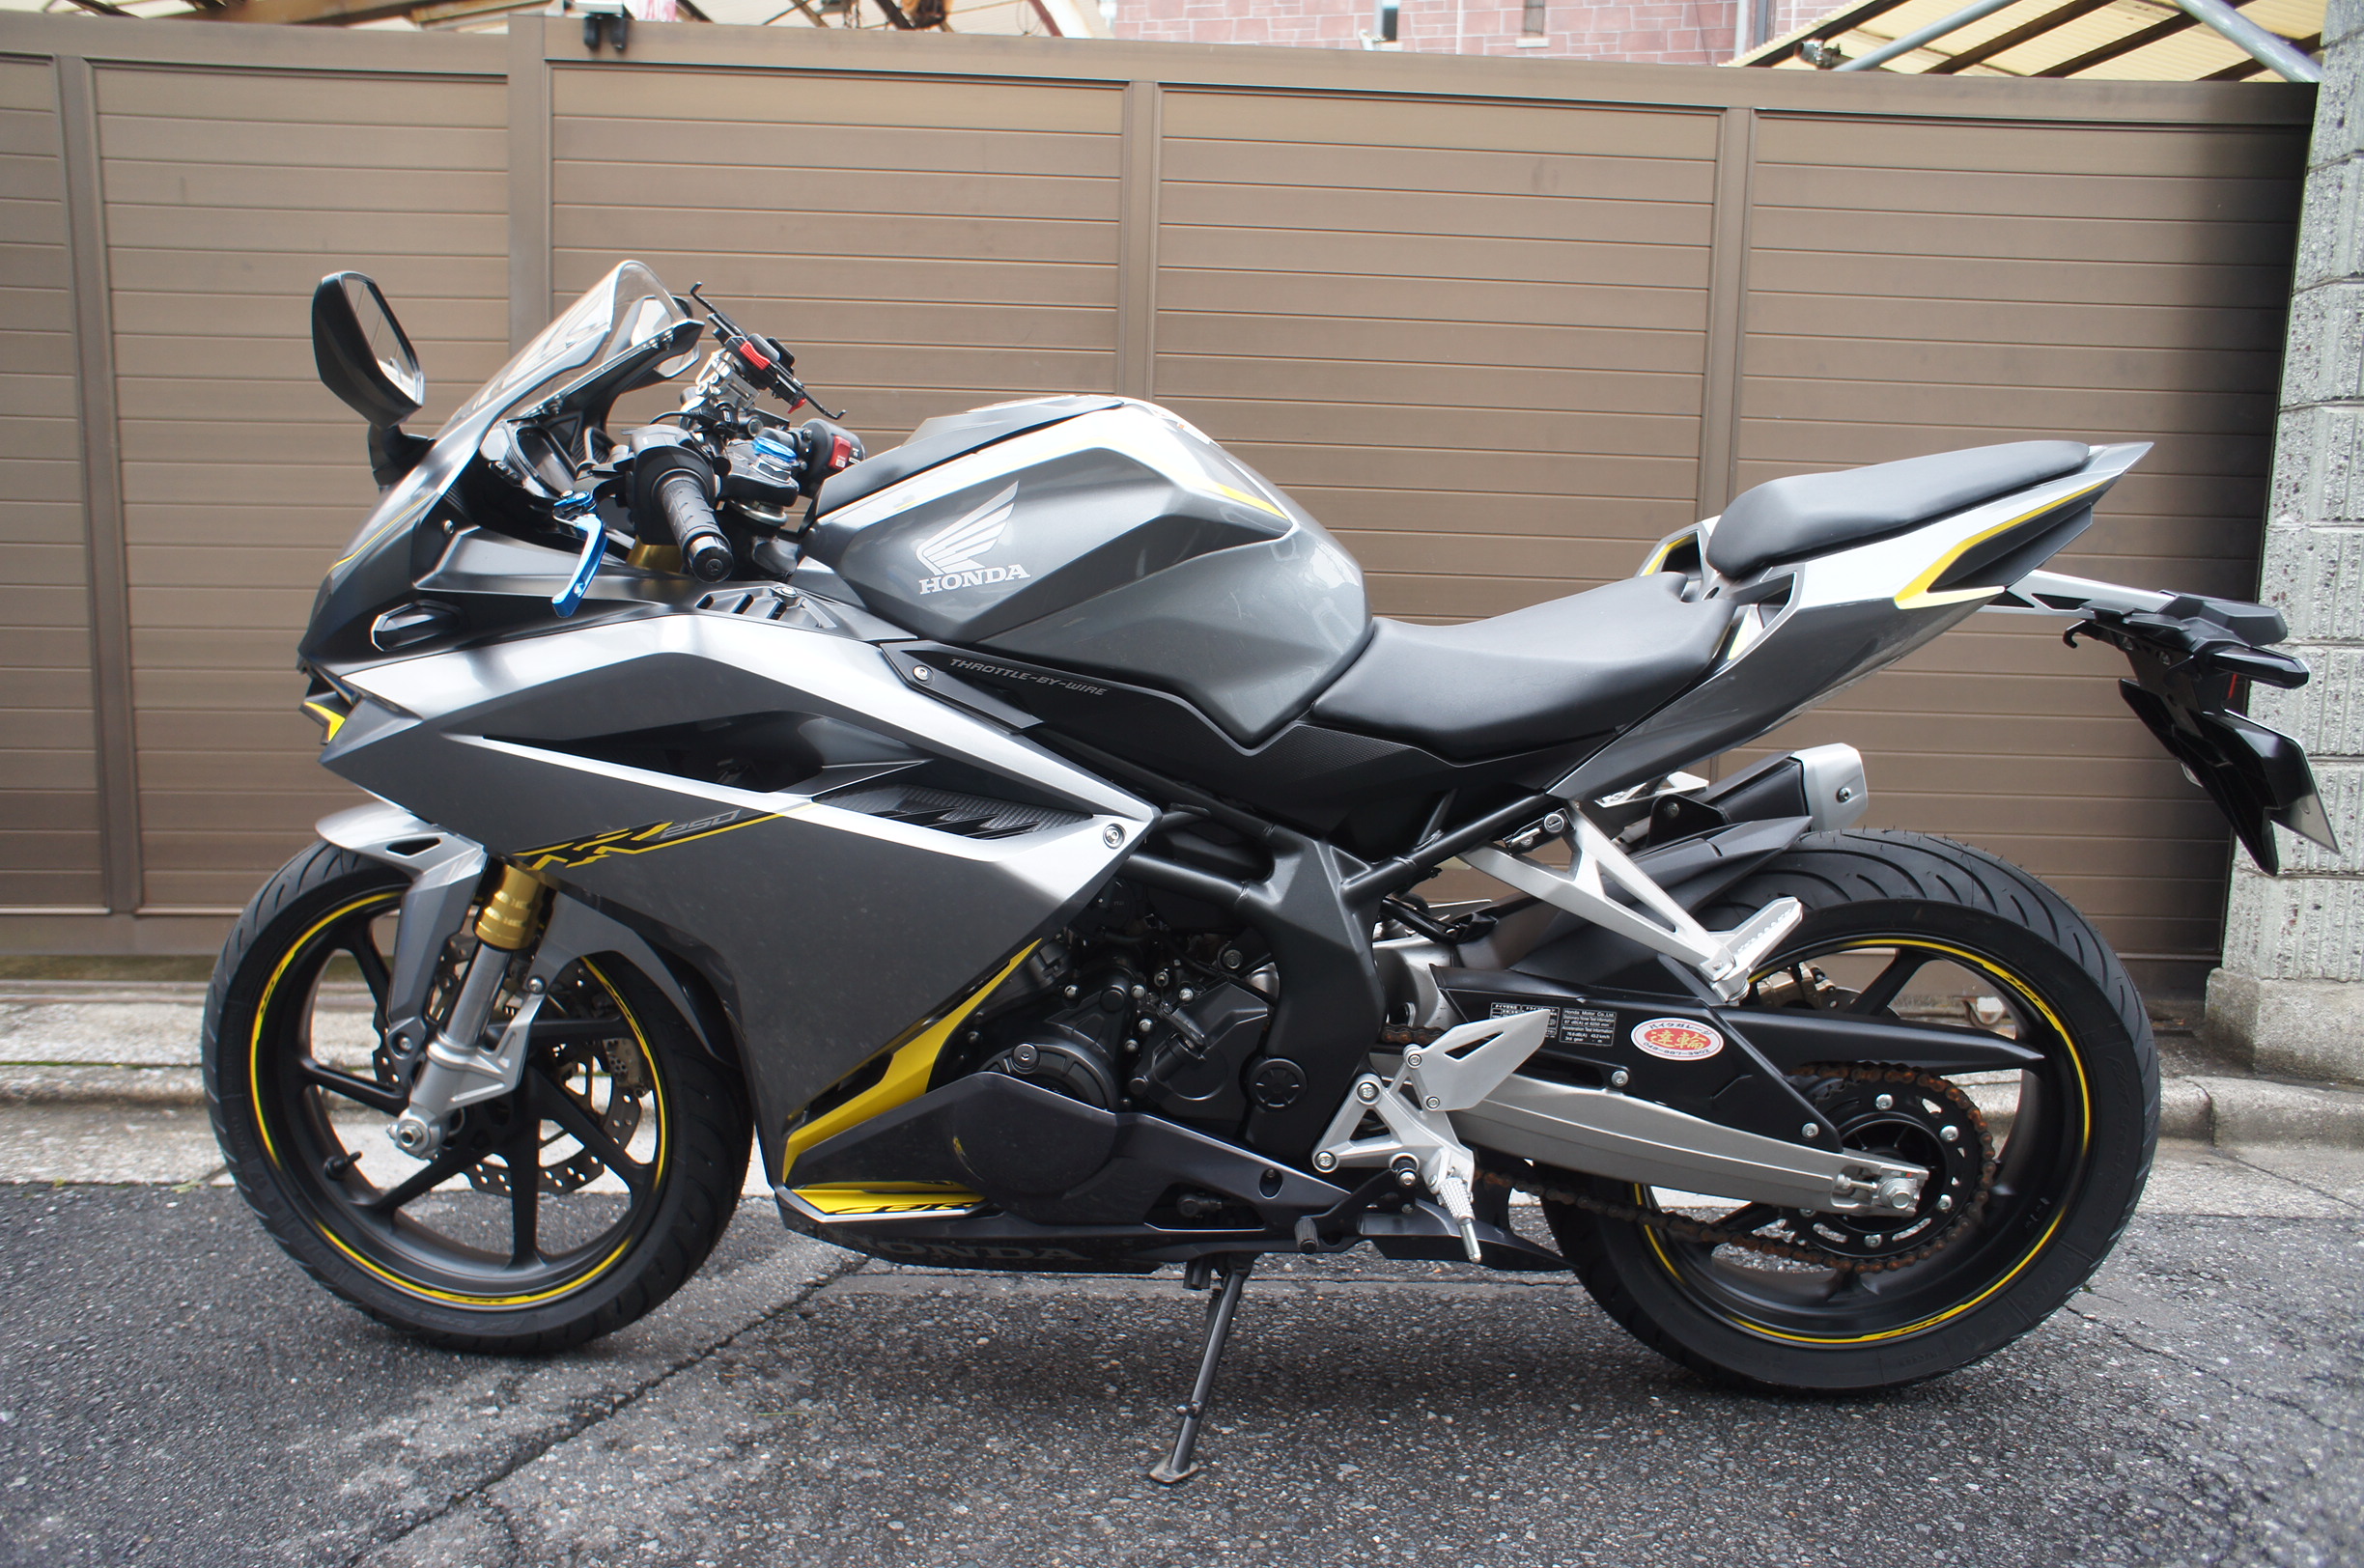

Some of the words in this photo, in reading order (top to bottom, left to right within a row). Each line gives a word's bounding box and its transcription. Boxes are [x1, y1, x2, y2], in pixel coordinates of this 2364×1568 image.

[918, 564, 1030, 595] HONDA
[950, 658, 1108, 696] THROTTLE-BY-WIRE
[659, 808, 742, 840] 250
[1648, 1022, 1712, 1036] バイクガレージ
